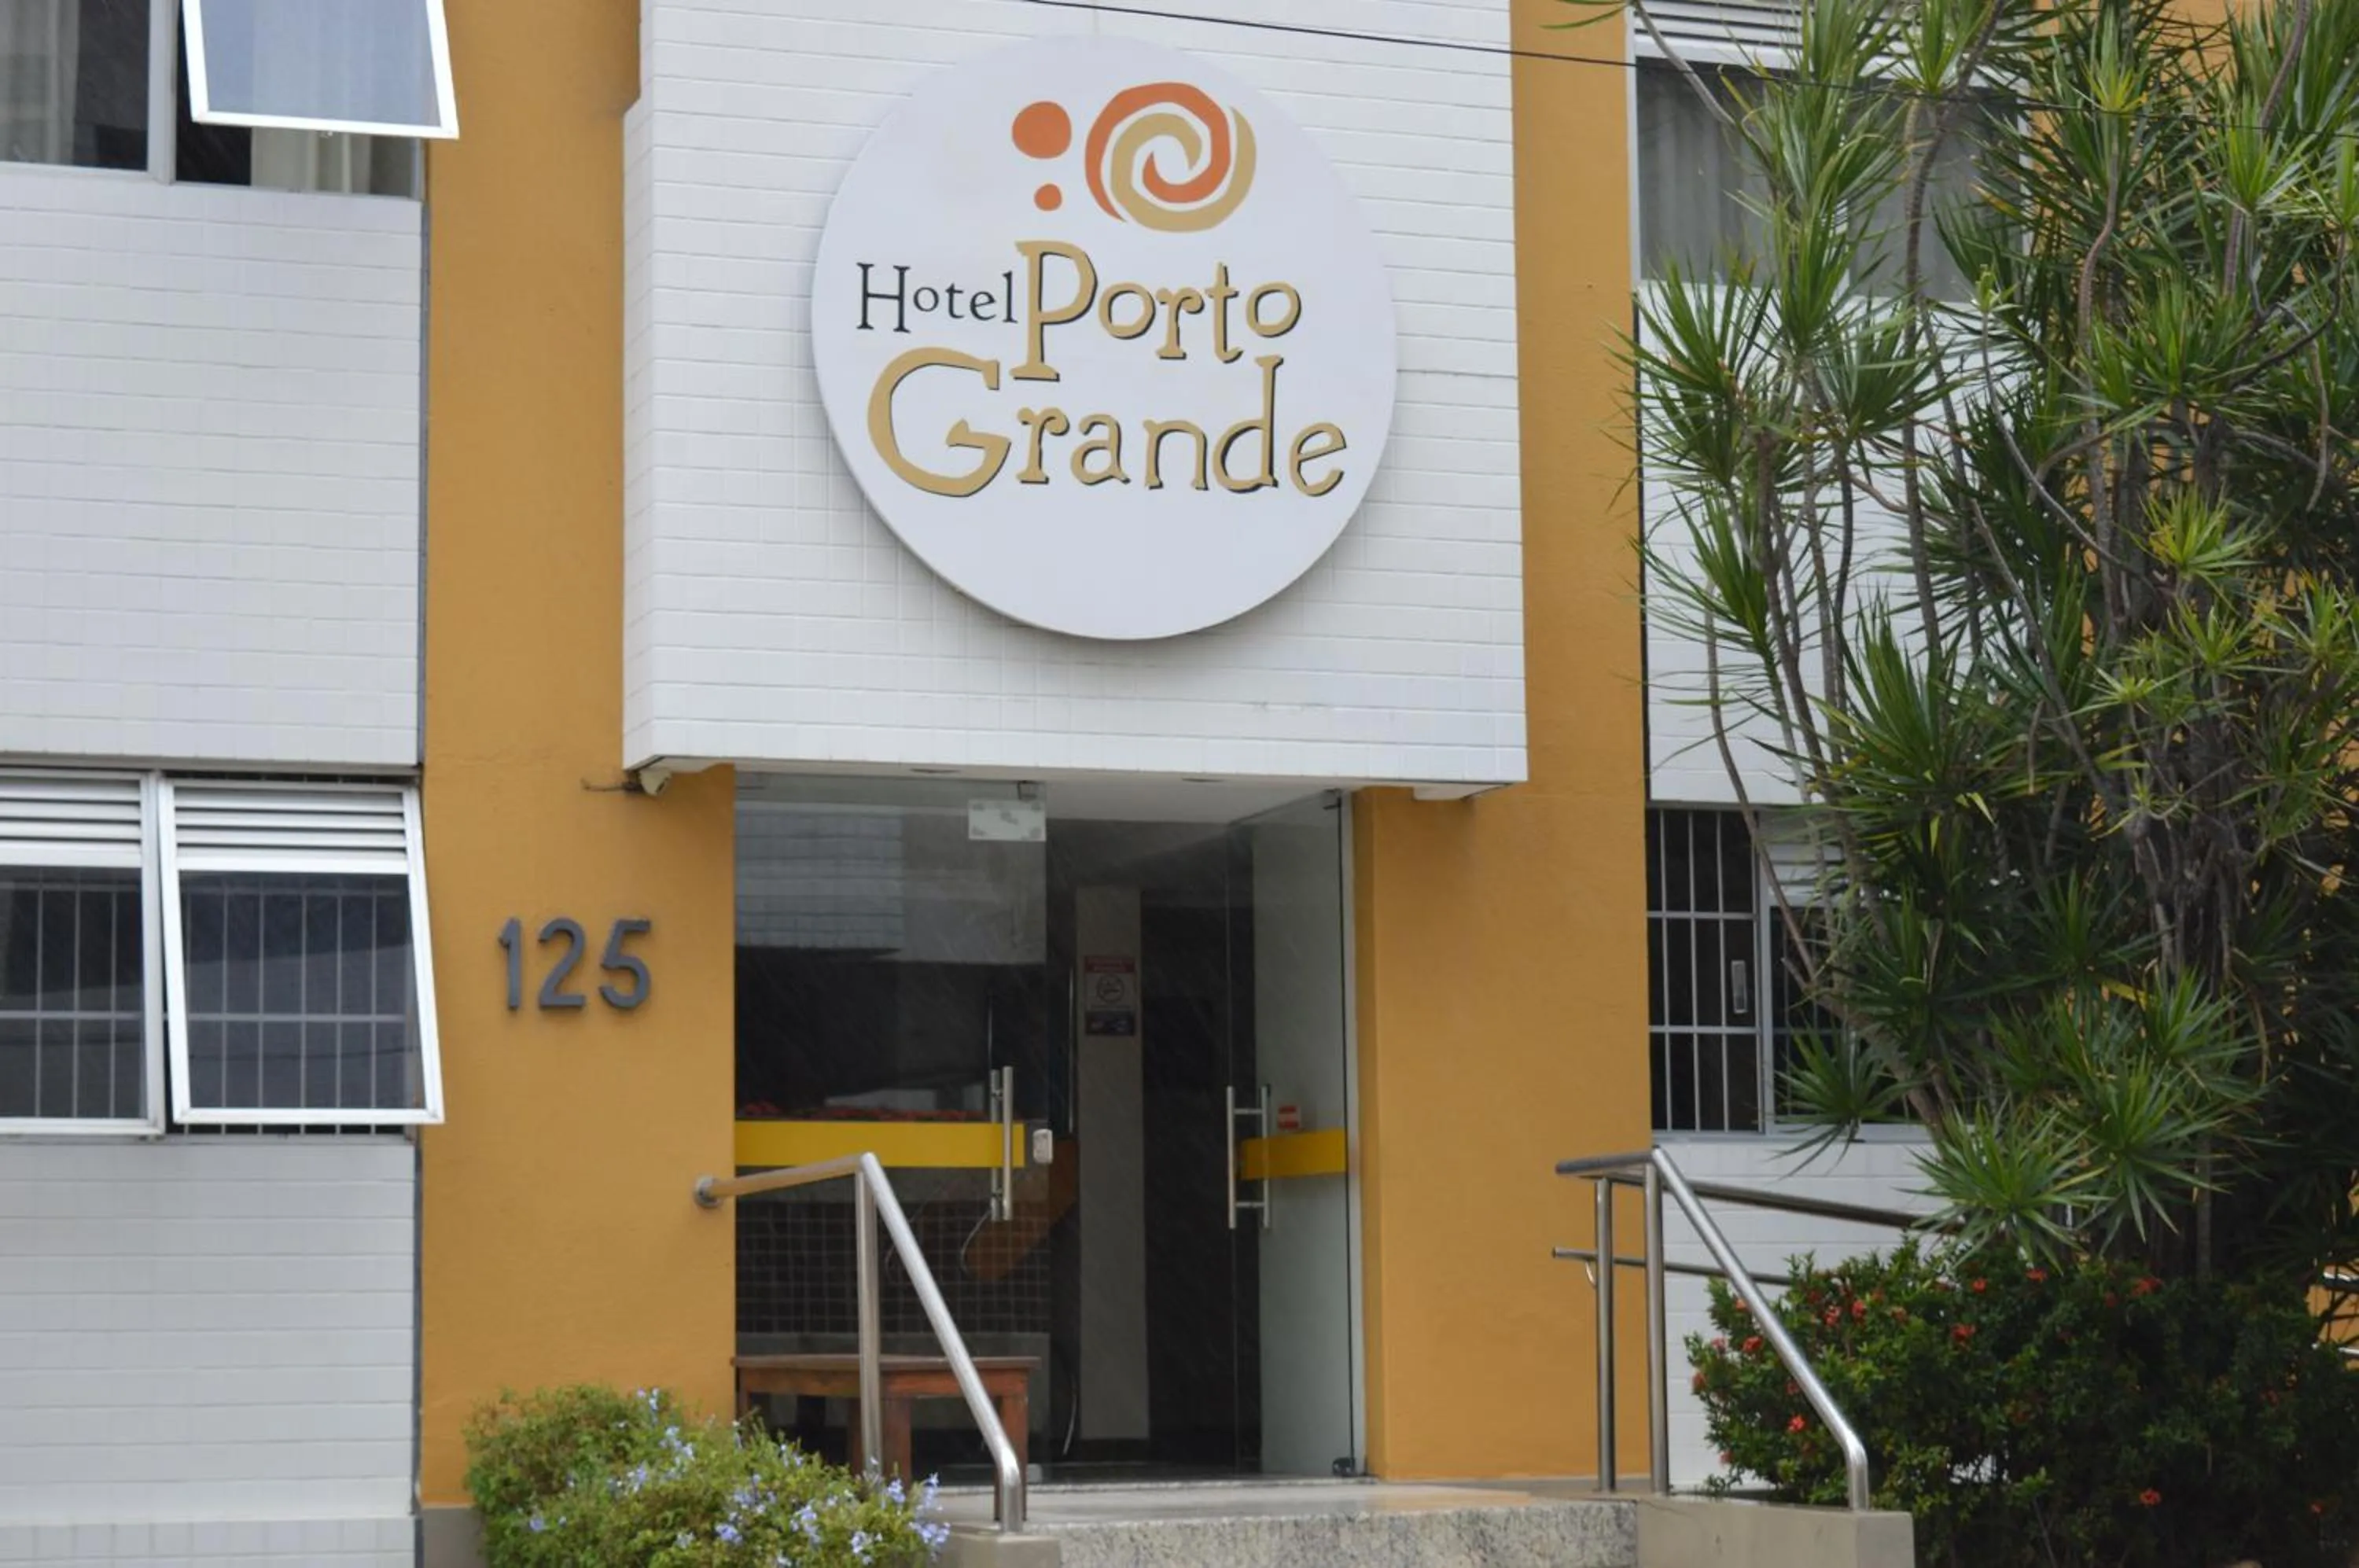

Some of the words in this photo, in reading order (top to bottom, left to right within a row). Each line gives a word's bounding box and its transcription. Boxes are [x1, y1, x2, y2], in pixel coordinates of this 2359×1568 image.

[856, 262, 1018, 333] Hotel
[1010, 241, 1301, 381] Porto
[867, 347, 1347, 497] Grande
[499, 918, 651, 1011] 125
